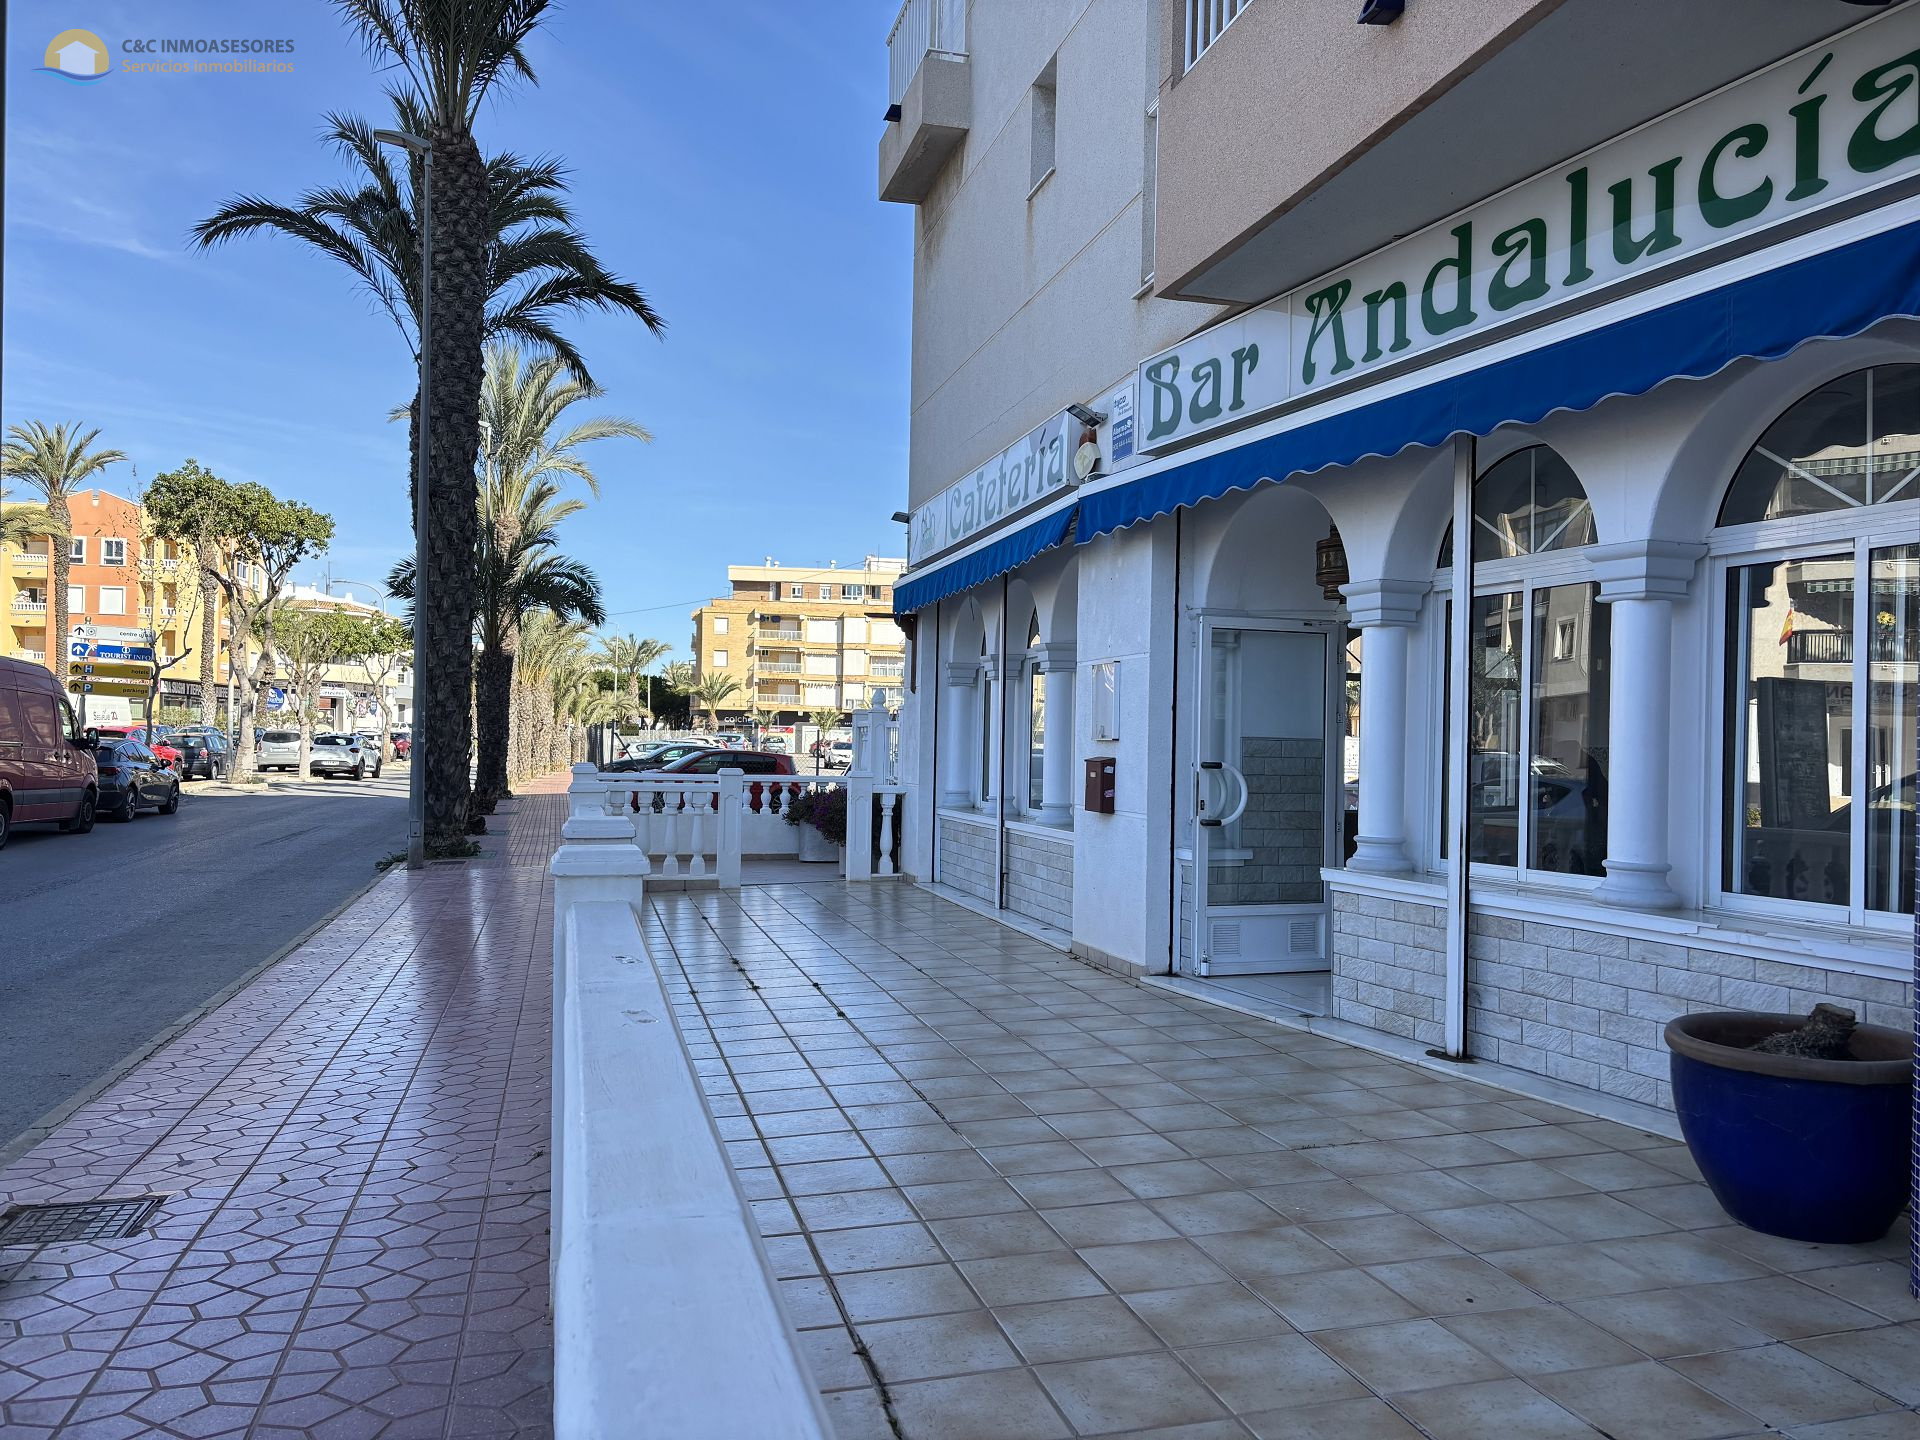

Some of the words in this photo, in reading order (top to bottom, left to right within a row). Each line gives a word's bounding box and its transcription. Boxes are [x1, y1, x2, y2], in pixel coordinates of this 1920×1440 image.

[1145, 341, 1259, 442] Bar
[1302, 49, 1920, 385] Andalucía
[950, 428, 1064, 540] Cafetería
[100, 652, 132, 660] TOURIST
[133, 653, 152, 661] INFO
[84, 684, 92, 692] P
